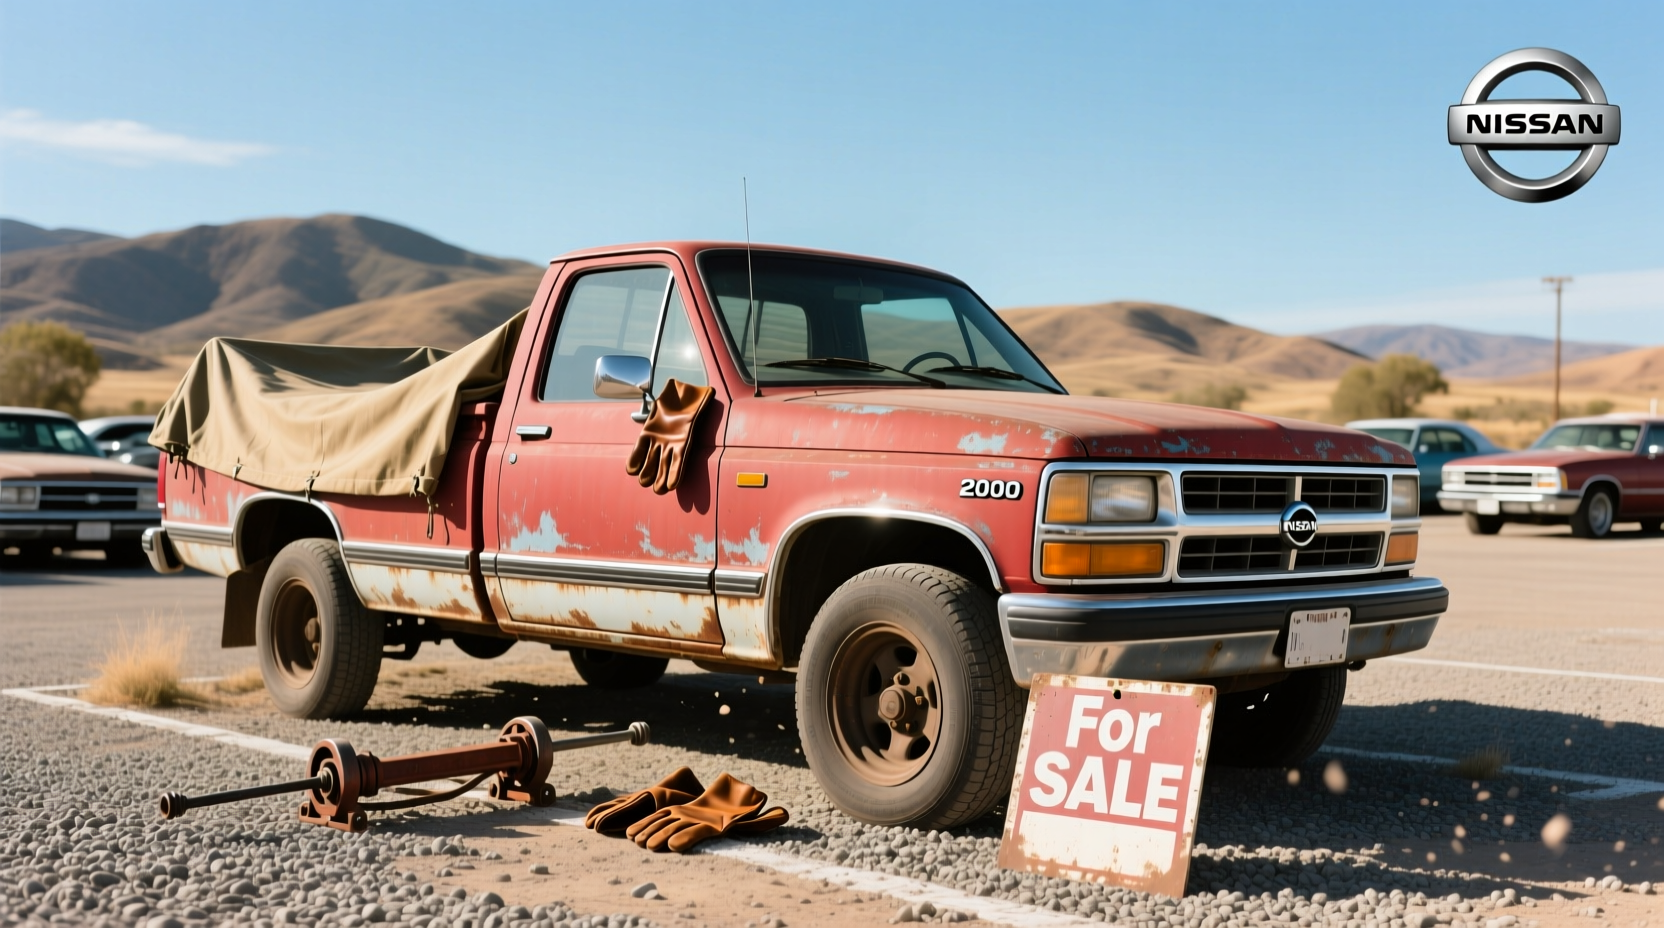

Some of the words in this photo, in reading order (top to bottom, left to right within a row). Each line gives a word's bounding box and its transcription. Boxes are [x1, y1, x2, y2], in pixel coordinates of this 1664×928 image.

[959, 478, 1023, 500] 2000
[1065, 694, 1162, 754] For
[1029, 751, 1184, 823] SALE
